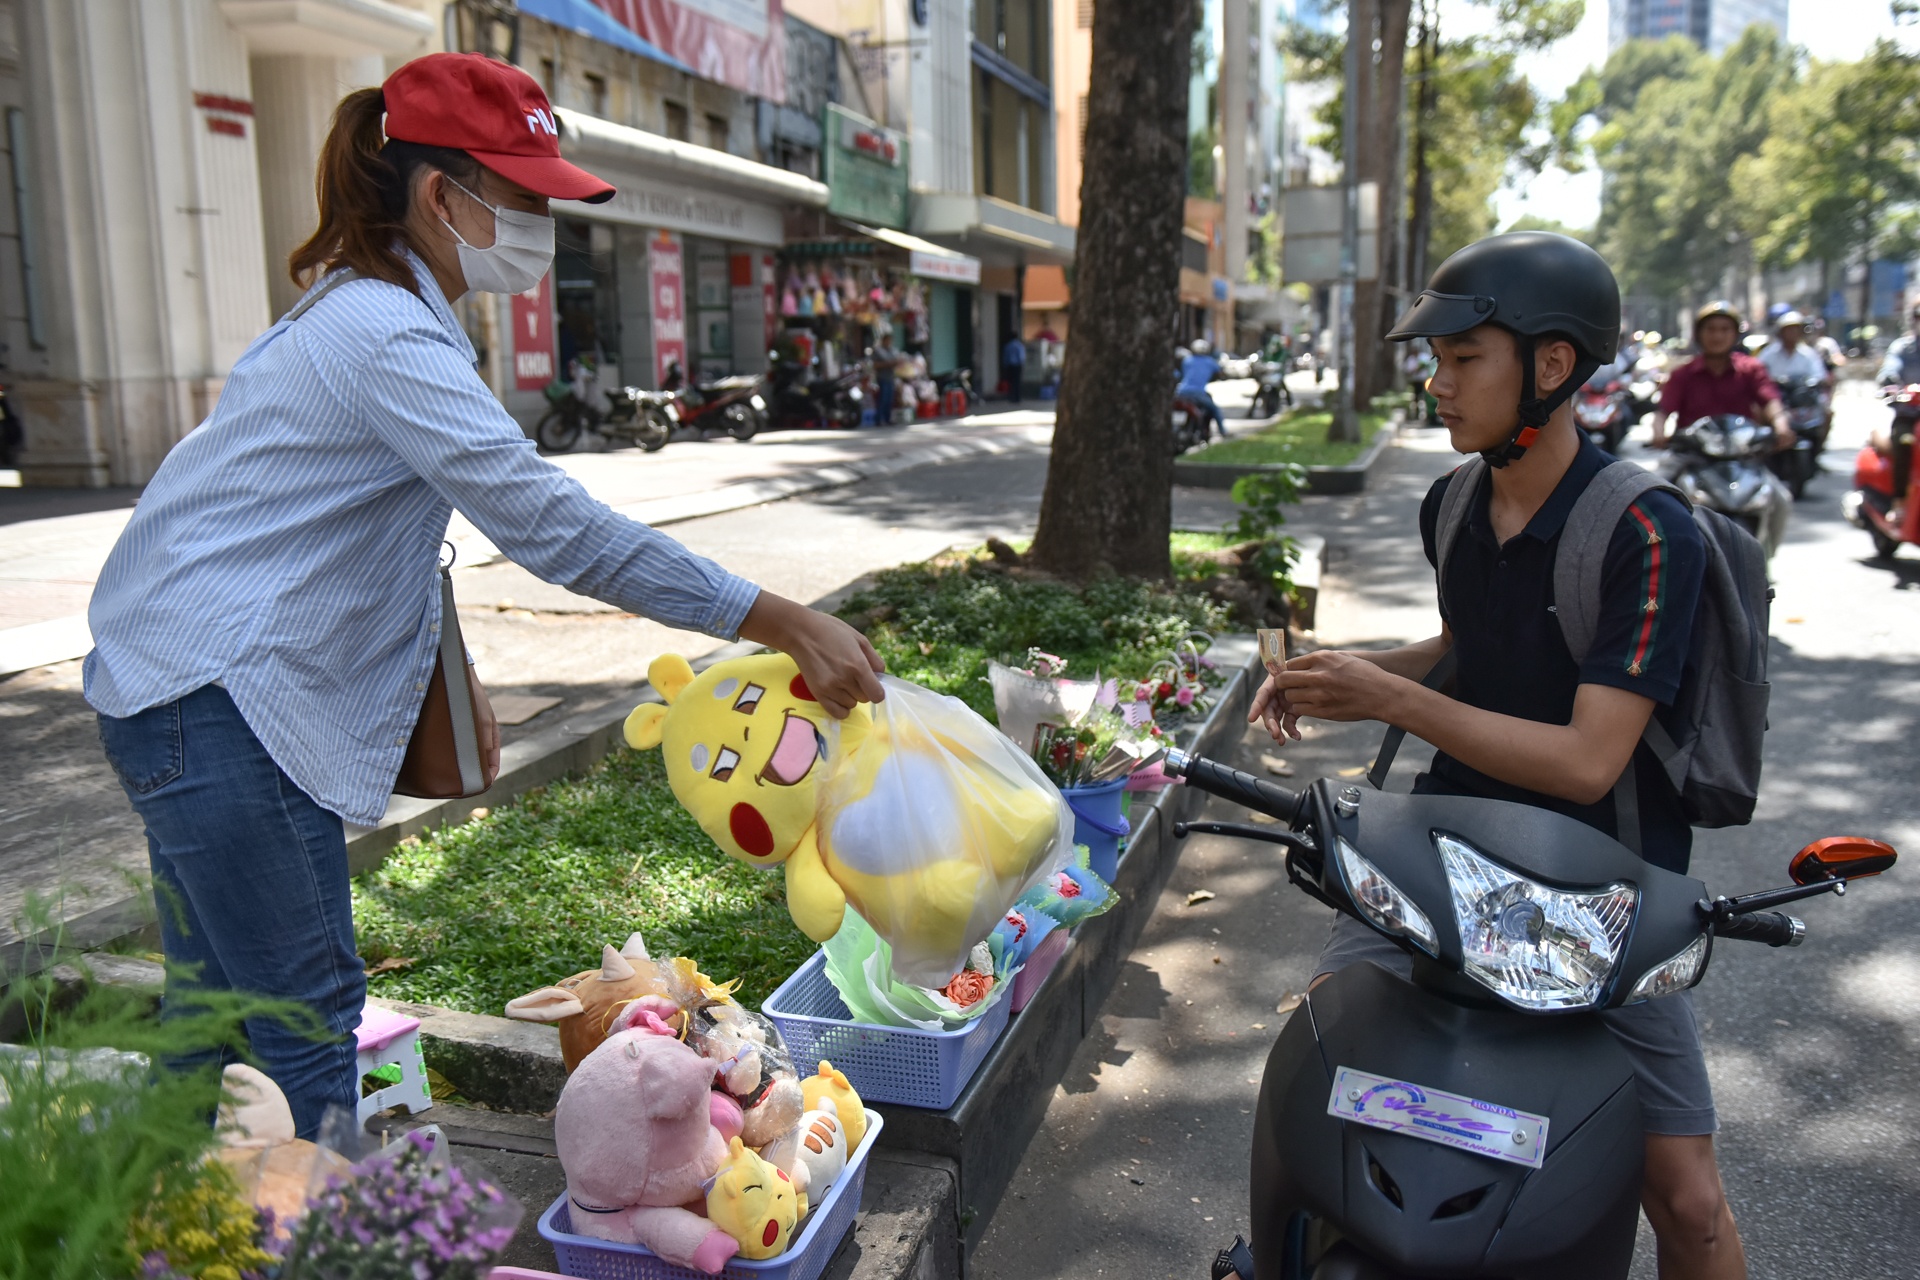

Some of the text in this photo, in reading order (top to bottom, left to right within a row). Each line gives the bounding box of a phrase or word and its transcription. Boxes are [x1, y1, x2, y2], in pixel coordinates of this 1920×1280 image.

[522, 106, 559, 136] FIL
[1473, 1101, 1516, 1118] HONDA
[1443, 1135, 1502, 1156] TITANIUM
